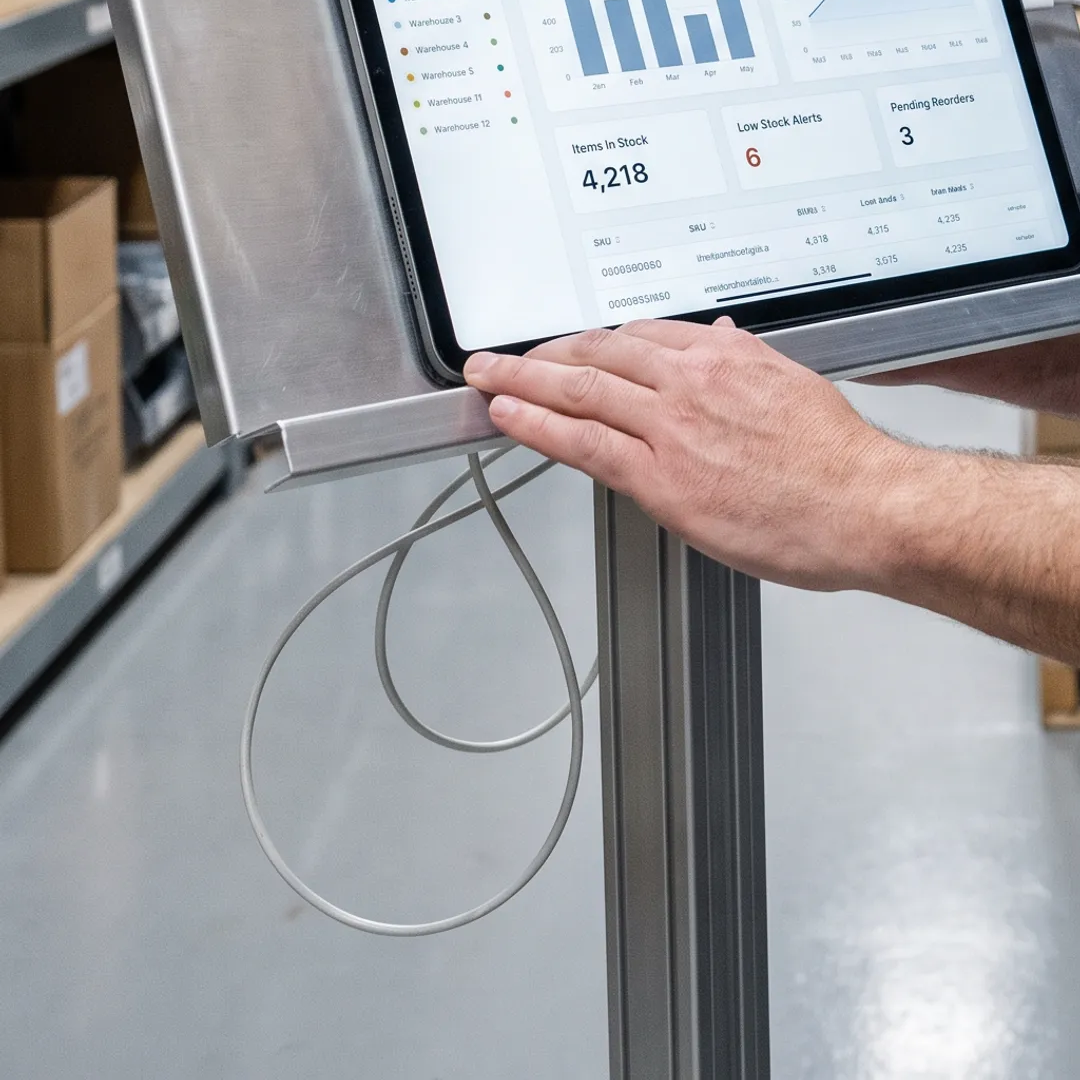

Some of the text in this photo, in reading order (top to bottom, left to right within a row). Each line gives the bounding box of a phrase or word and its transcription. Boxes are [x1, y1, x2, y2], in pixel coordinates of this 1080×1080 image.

[456, 15, 461, 23] 3
[415, 44, 460, 53] Warehouse
[421, 67, 474, 80] Warehouse 5
[427, 97, 471, 106] Warehouse
[891, 94, 974, 112] Pending Reorders
[434, 123, 479, 133] Warehouse
[737, 114, 822, 132] Low Stock Alerts
[572, 135, 648, 153] Items In Stock
[900, 127, 914, 145] 3
[746, 148, 761, 167] 6
[583, 163, 648, 193] 4,218
